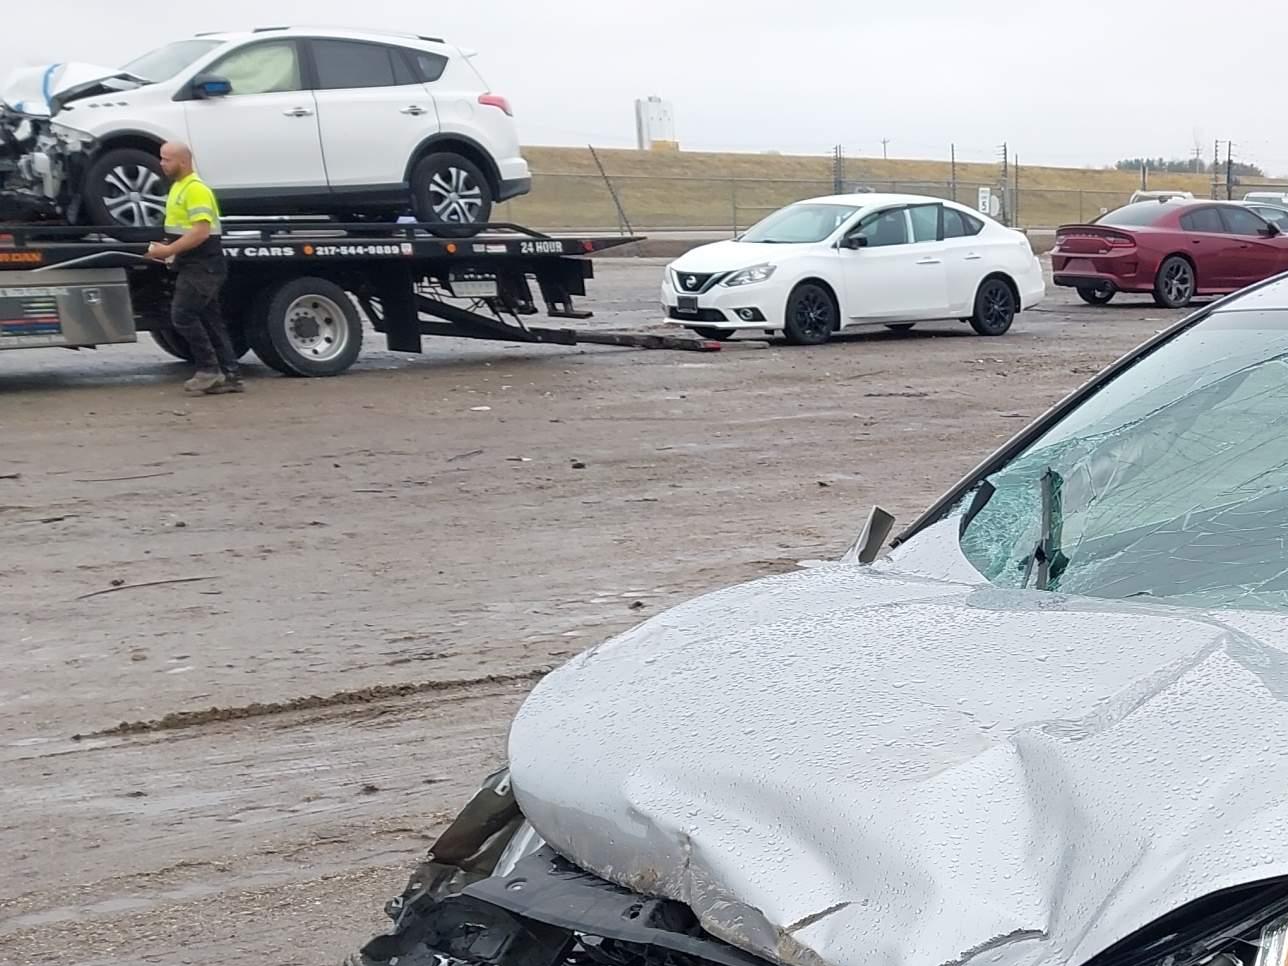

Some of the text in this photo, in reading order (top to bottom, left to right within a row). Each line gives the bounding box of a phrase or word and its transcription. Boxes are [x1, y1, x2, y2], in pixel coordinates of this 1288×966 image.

[244, 246, 296, 257] CARS
[520, 241, 534, 253] 24
[535, 241, 563, 253] HOUR
